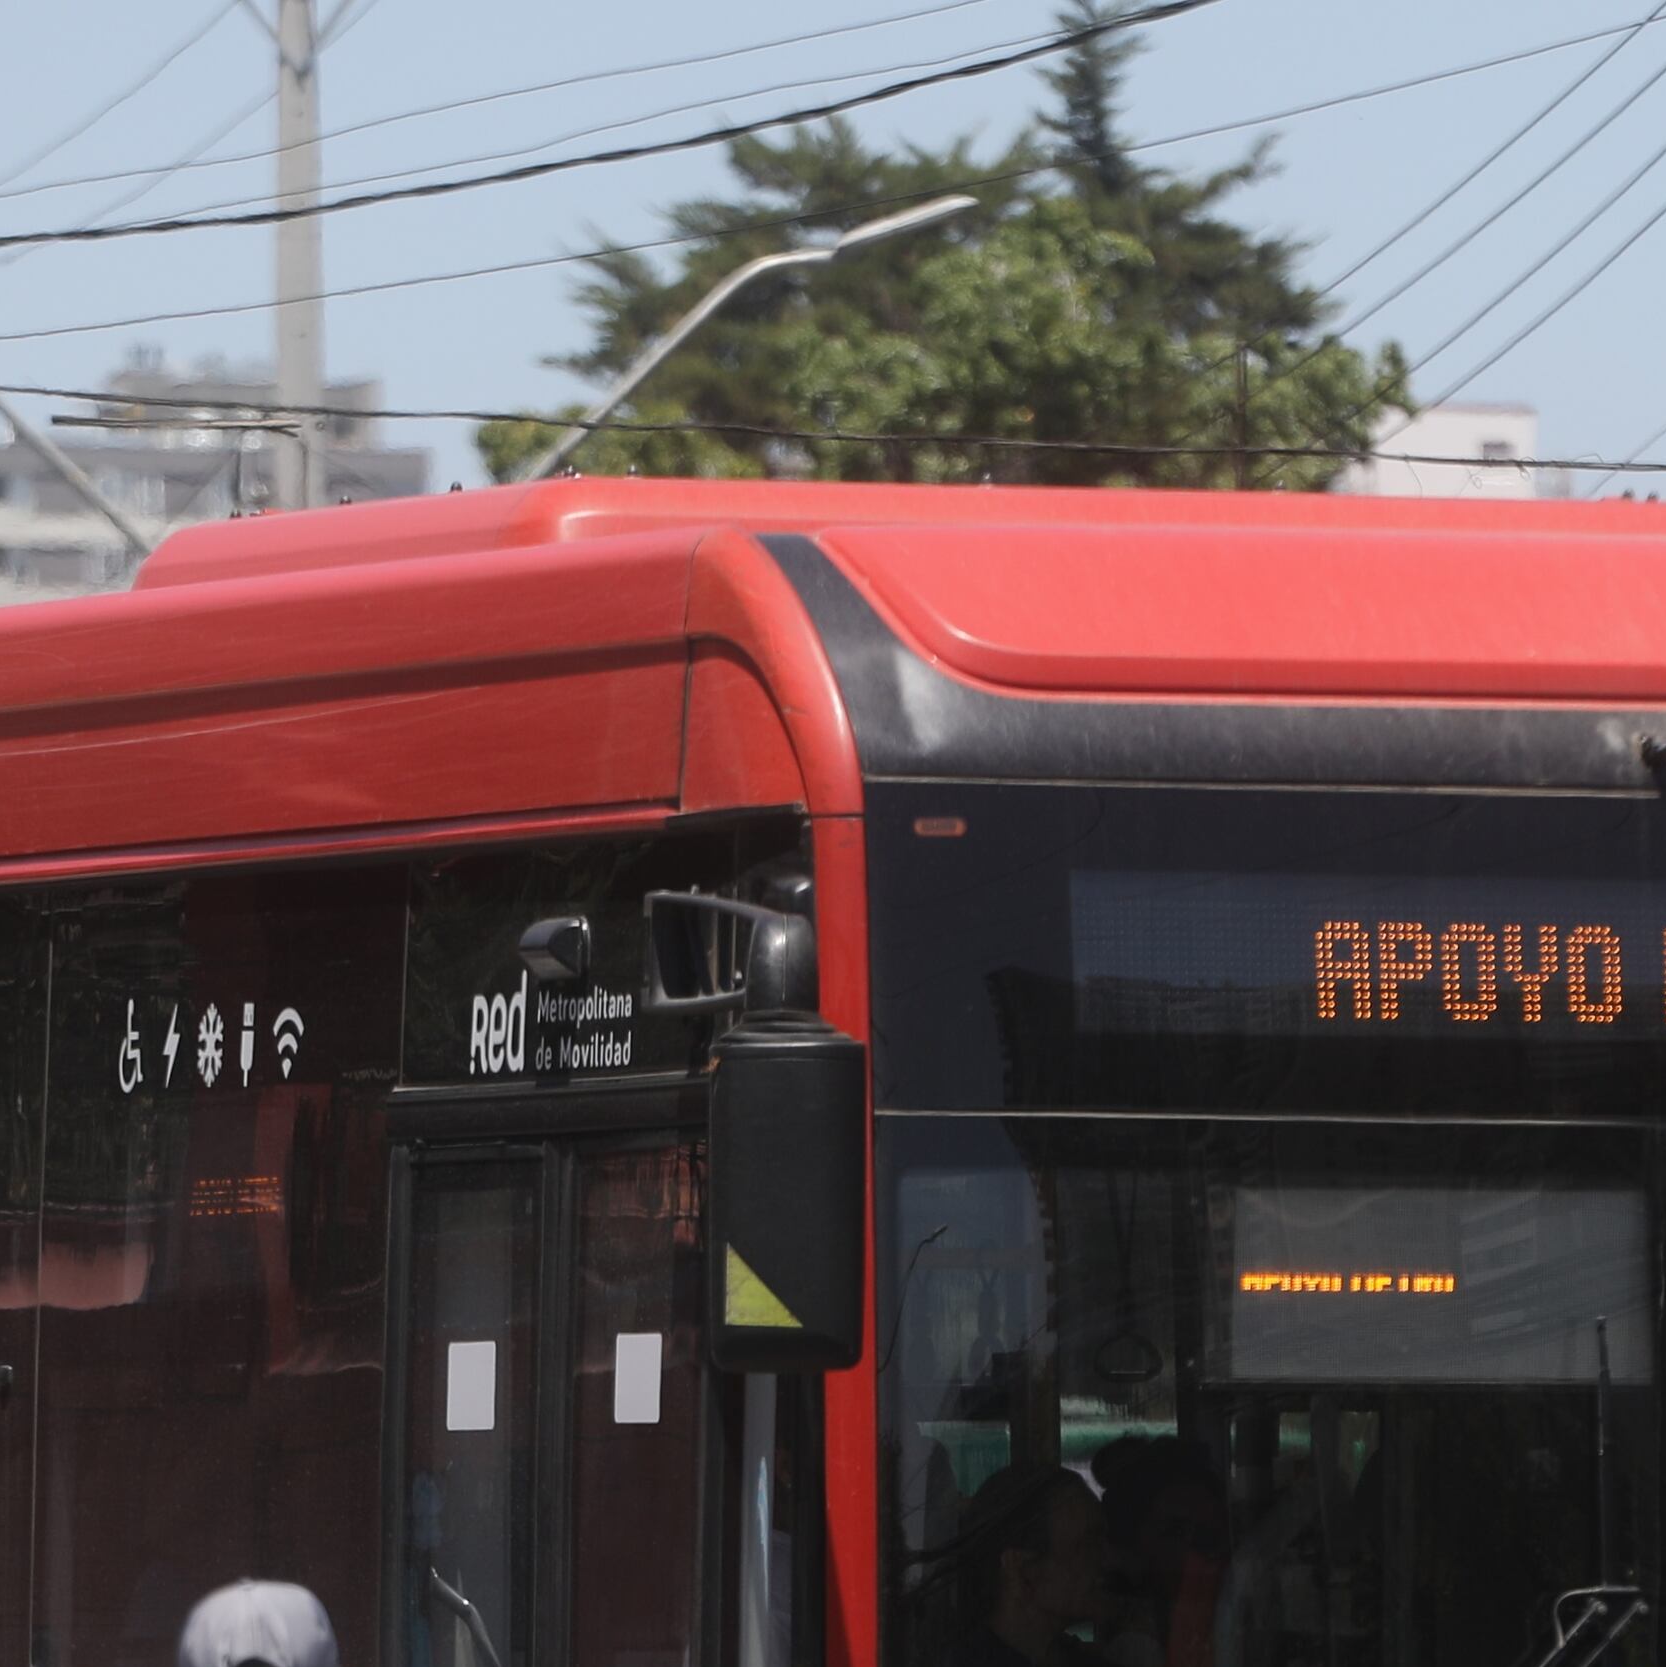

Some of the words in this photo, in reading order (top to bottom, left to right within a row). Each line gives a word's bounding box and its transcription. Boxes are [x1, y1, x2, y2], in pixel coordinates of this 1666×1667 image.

[537, 984, 633, 1030] Metropolitana
[1314, 920, 1622, 1022] APOYO
[470, 969, 528, 1075] Red
[535, 1036, 552, 1071] de
[559, 1030, 632, 1070] Movilidad
